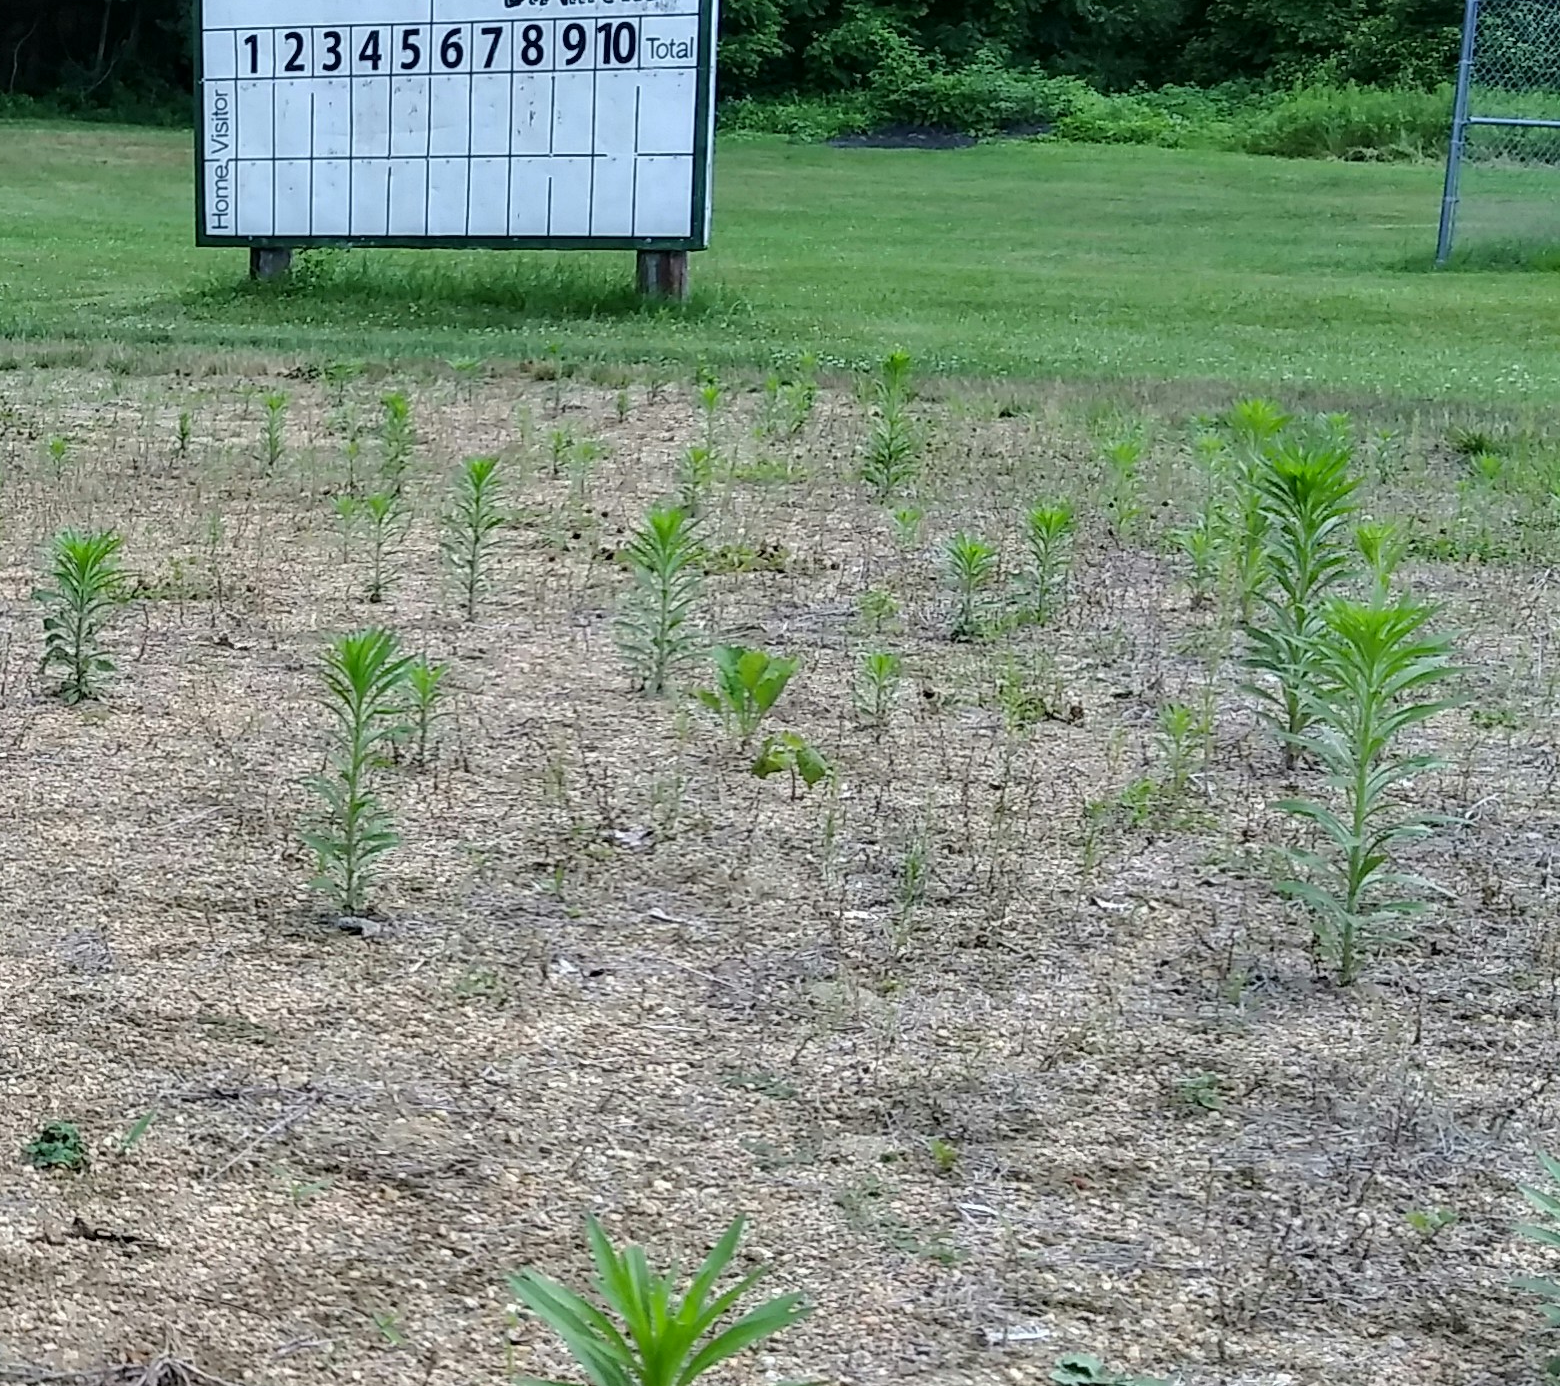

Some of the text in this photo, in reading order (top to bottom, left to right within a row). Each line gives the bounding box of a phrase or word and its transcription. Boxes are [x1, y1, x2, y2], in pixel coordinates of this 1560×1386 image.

[243, 21, 694, 74] 1 2 3 4 5 6 7 8 9 10 Total
[211, 89, 229, 154] Visitor
[211, 162, 229, 230] Home
